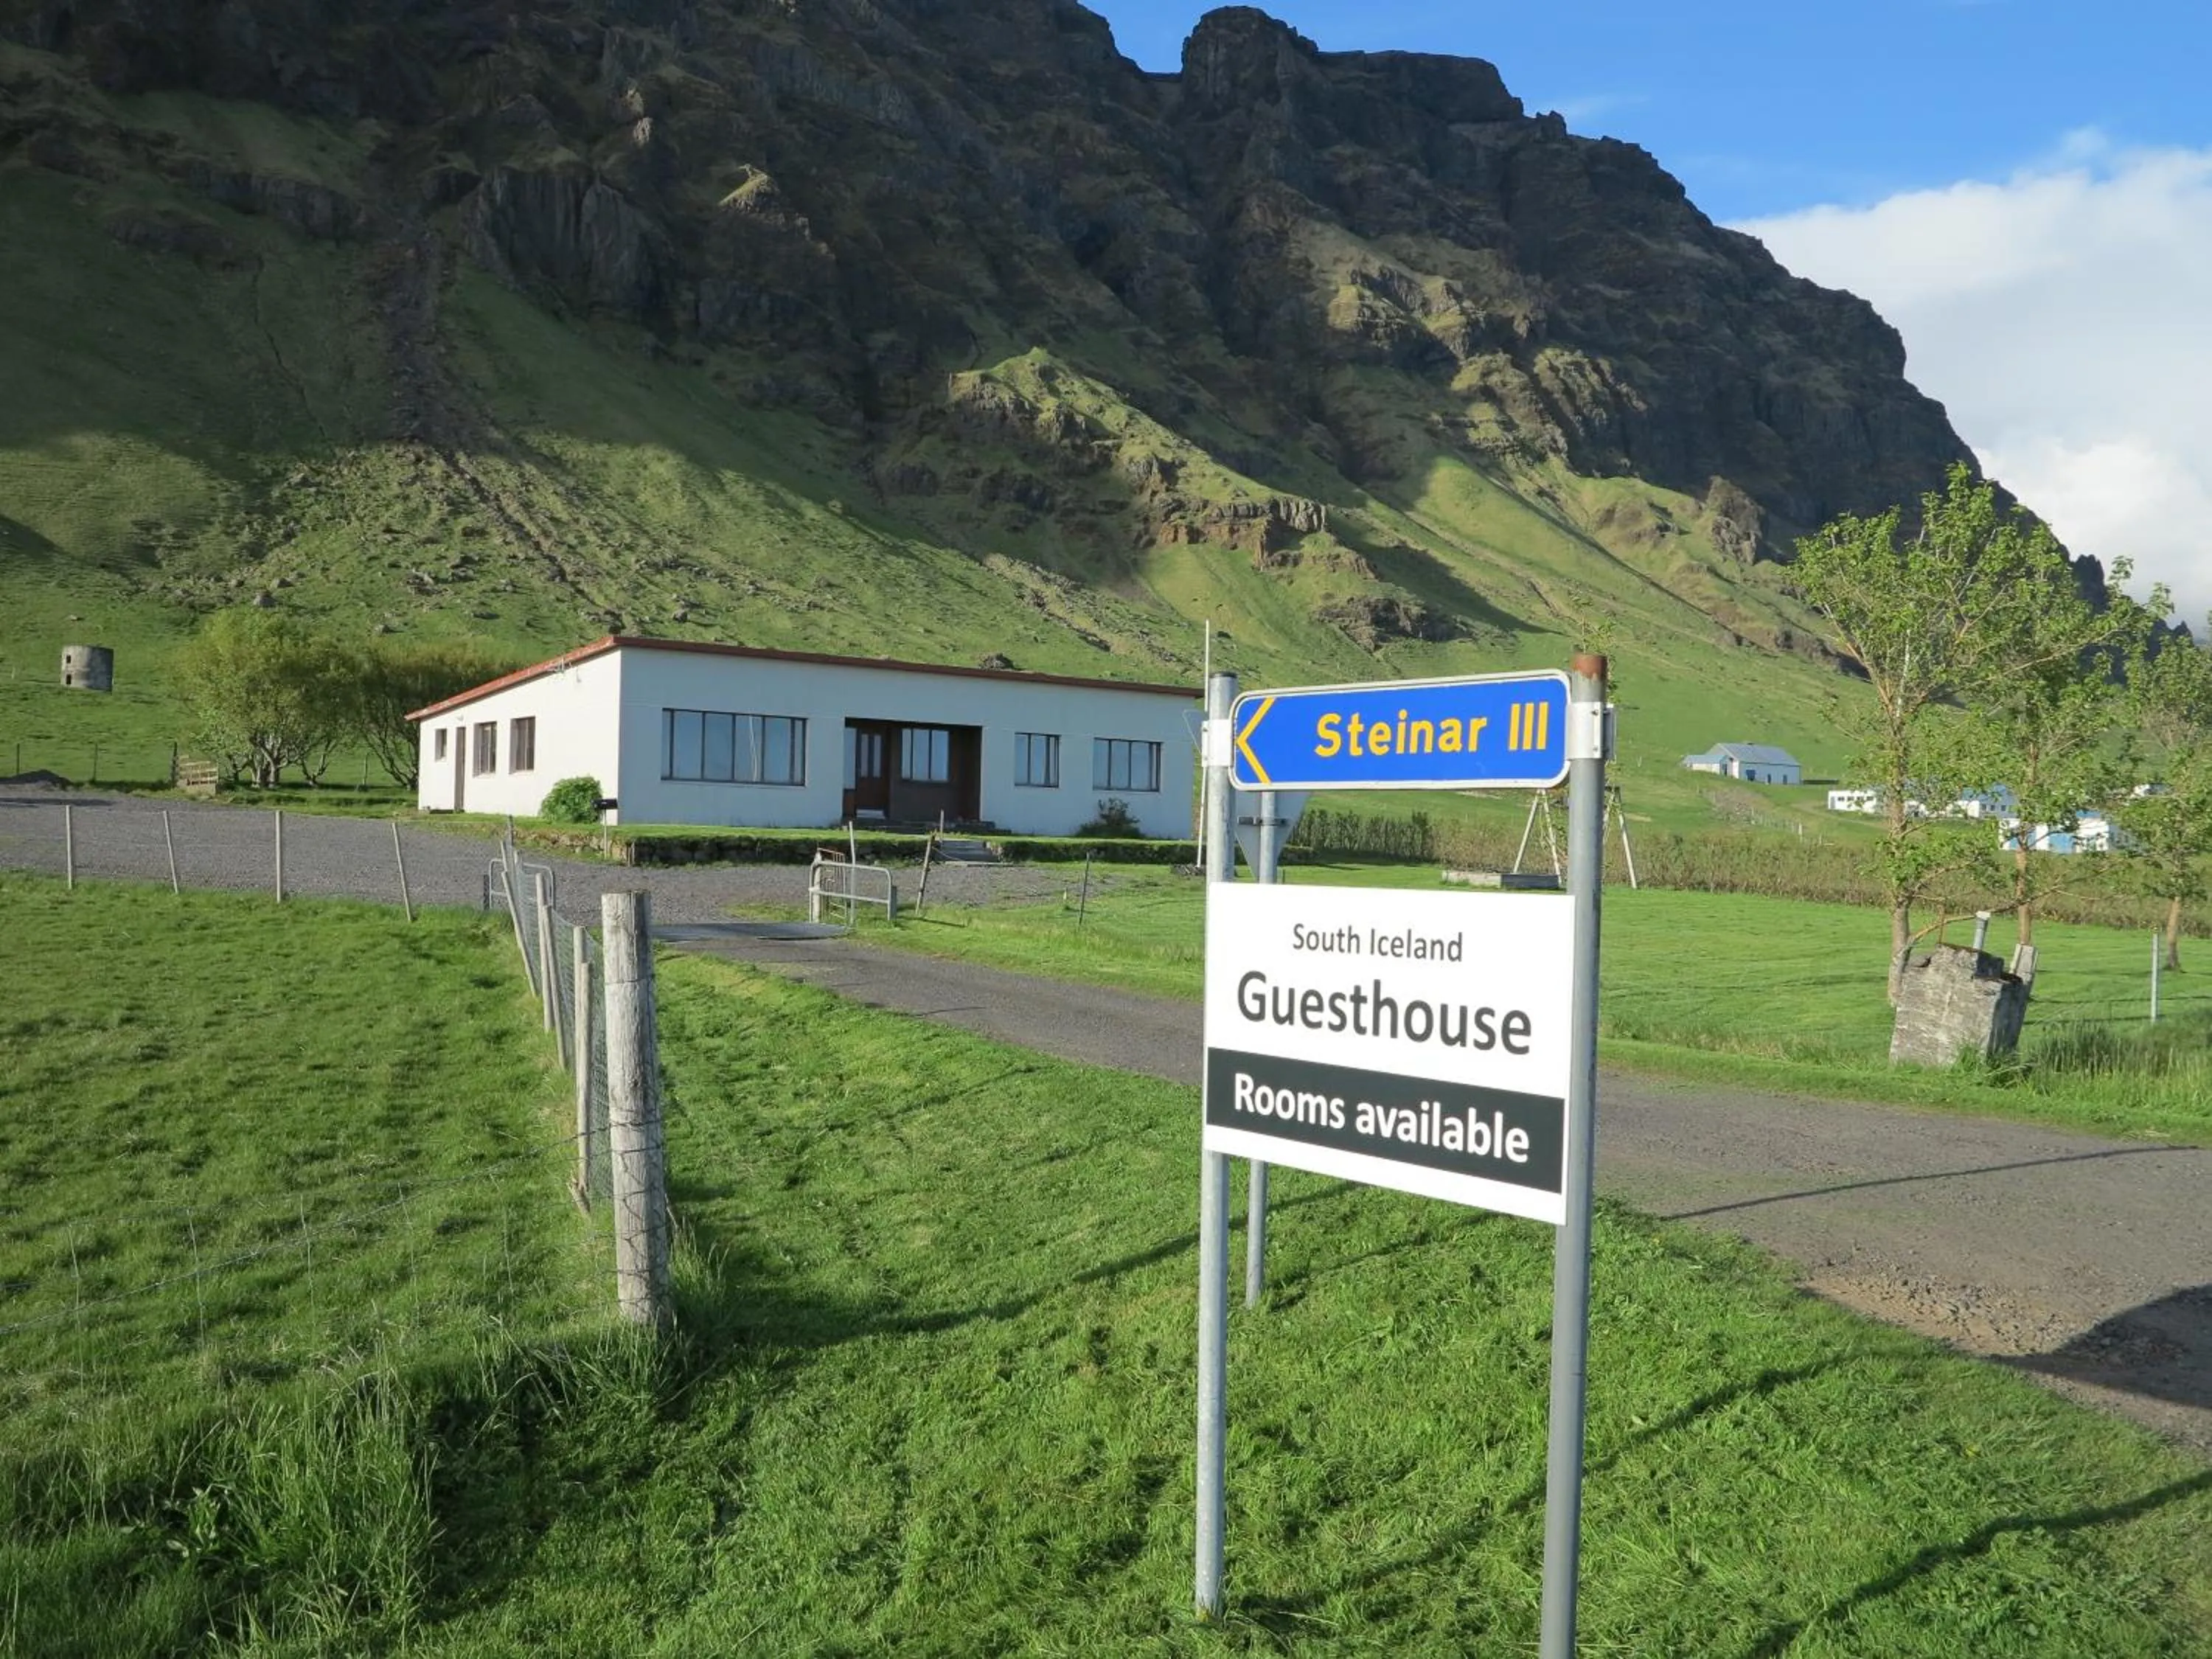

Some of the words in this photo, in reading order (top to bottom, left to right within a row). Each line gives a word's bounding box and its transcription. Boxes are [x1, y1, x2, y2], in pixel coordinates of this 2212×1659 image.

[1315, 709, 1486, 757] Steinar
[1509, 702, 1548, 750] III
[1293, 923, 1361, 955] South
[1370, 928, 1463, 962] Iceland
[1237, 970, 1532, 1055] Guesthouse
[1234, 1073, 1346, 1130] Rooms
[1356, 1099, 1530, 1163] available
